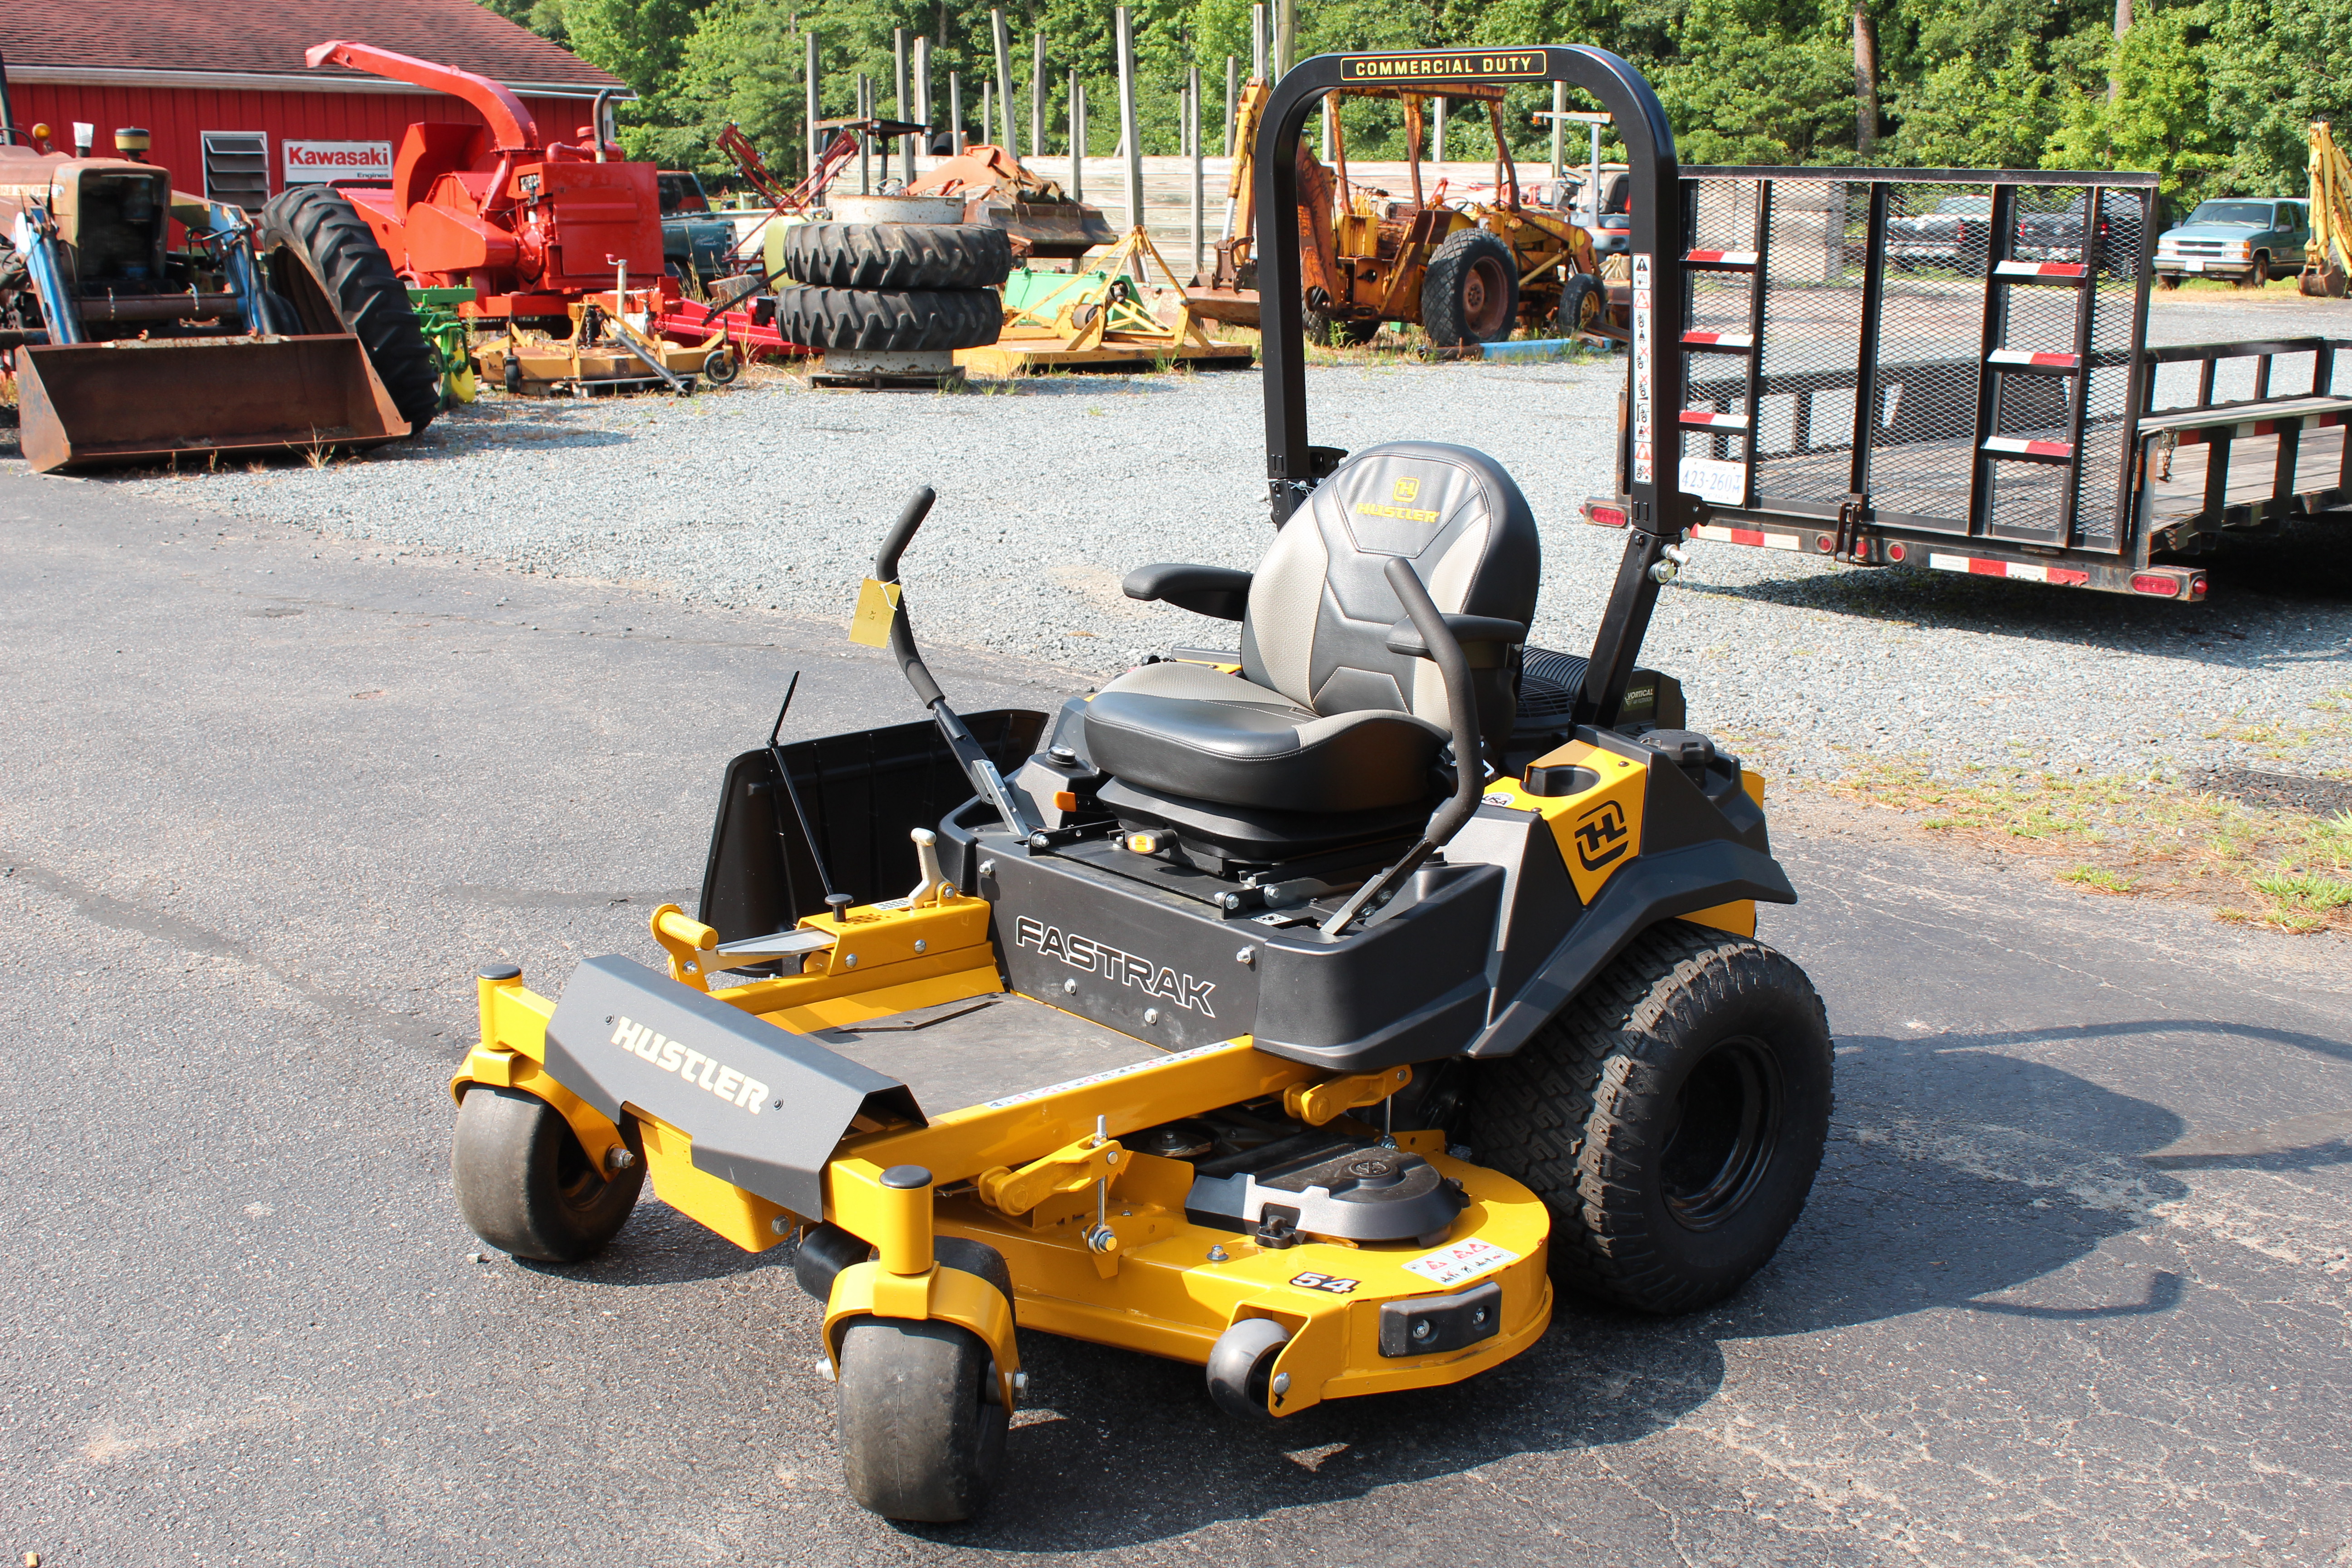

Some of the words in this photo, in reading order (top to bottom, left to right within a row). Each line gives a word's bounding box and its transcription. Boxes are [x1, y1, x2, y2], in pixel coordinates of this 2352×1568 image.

[1356, 58, 1474, 76] COMMERCIAL
[1483, 57, 1532, 72] DUTY
[288, 147, 388, 165] Kawasaki
[1682, 470, 1732, 492] 423-260
[1356, 502, 1440, 523] HUSTLER
[1627, 689, 1653, 699] VORTICAL
[1482, 795, 1507, 805] USA
[1016, 915, 1215, 1018] FASTRAK
[610, 1016, 769, 1115] HUSTLER
[1292, 1272, 1356, 1293] 54
